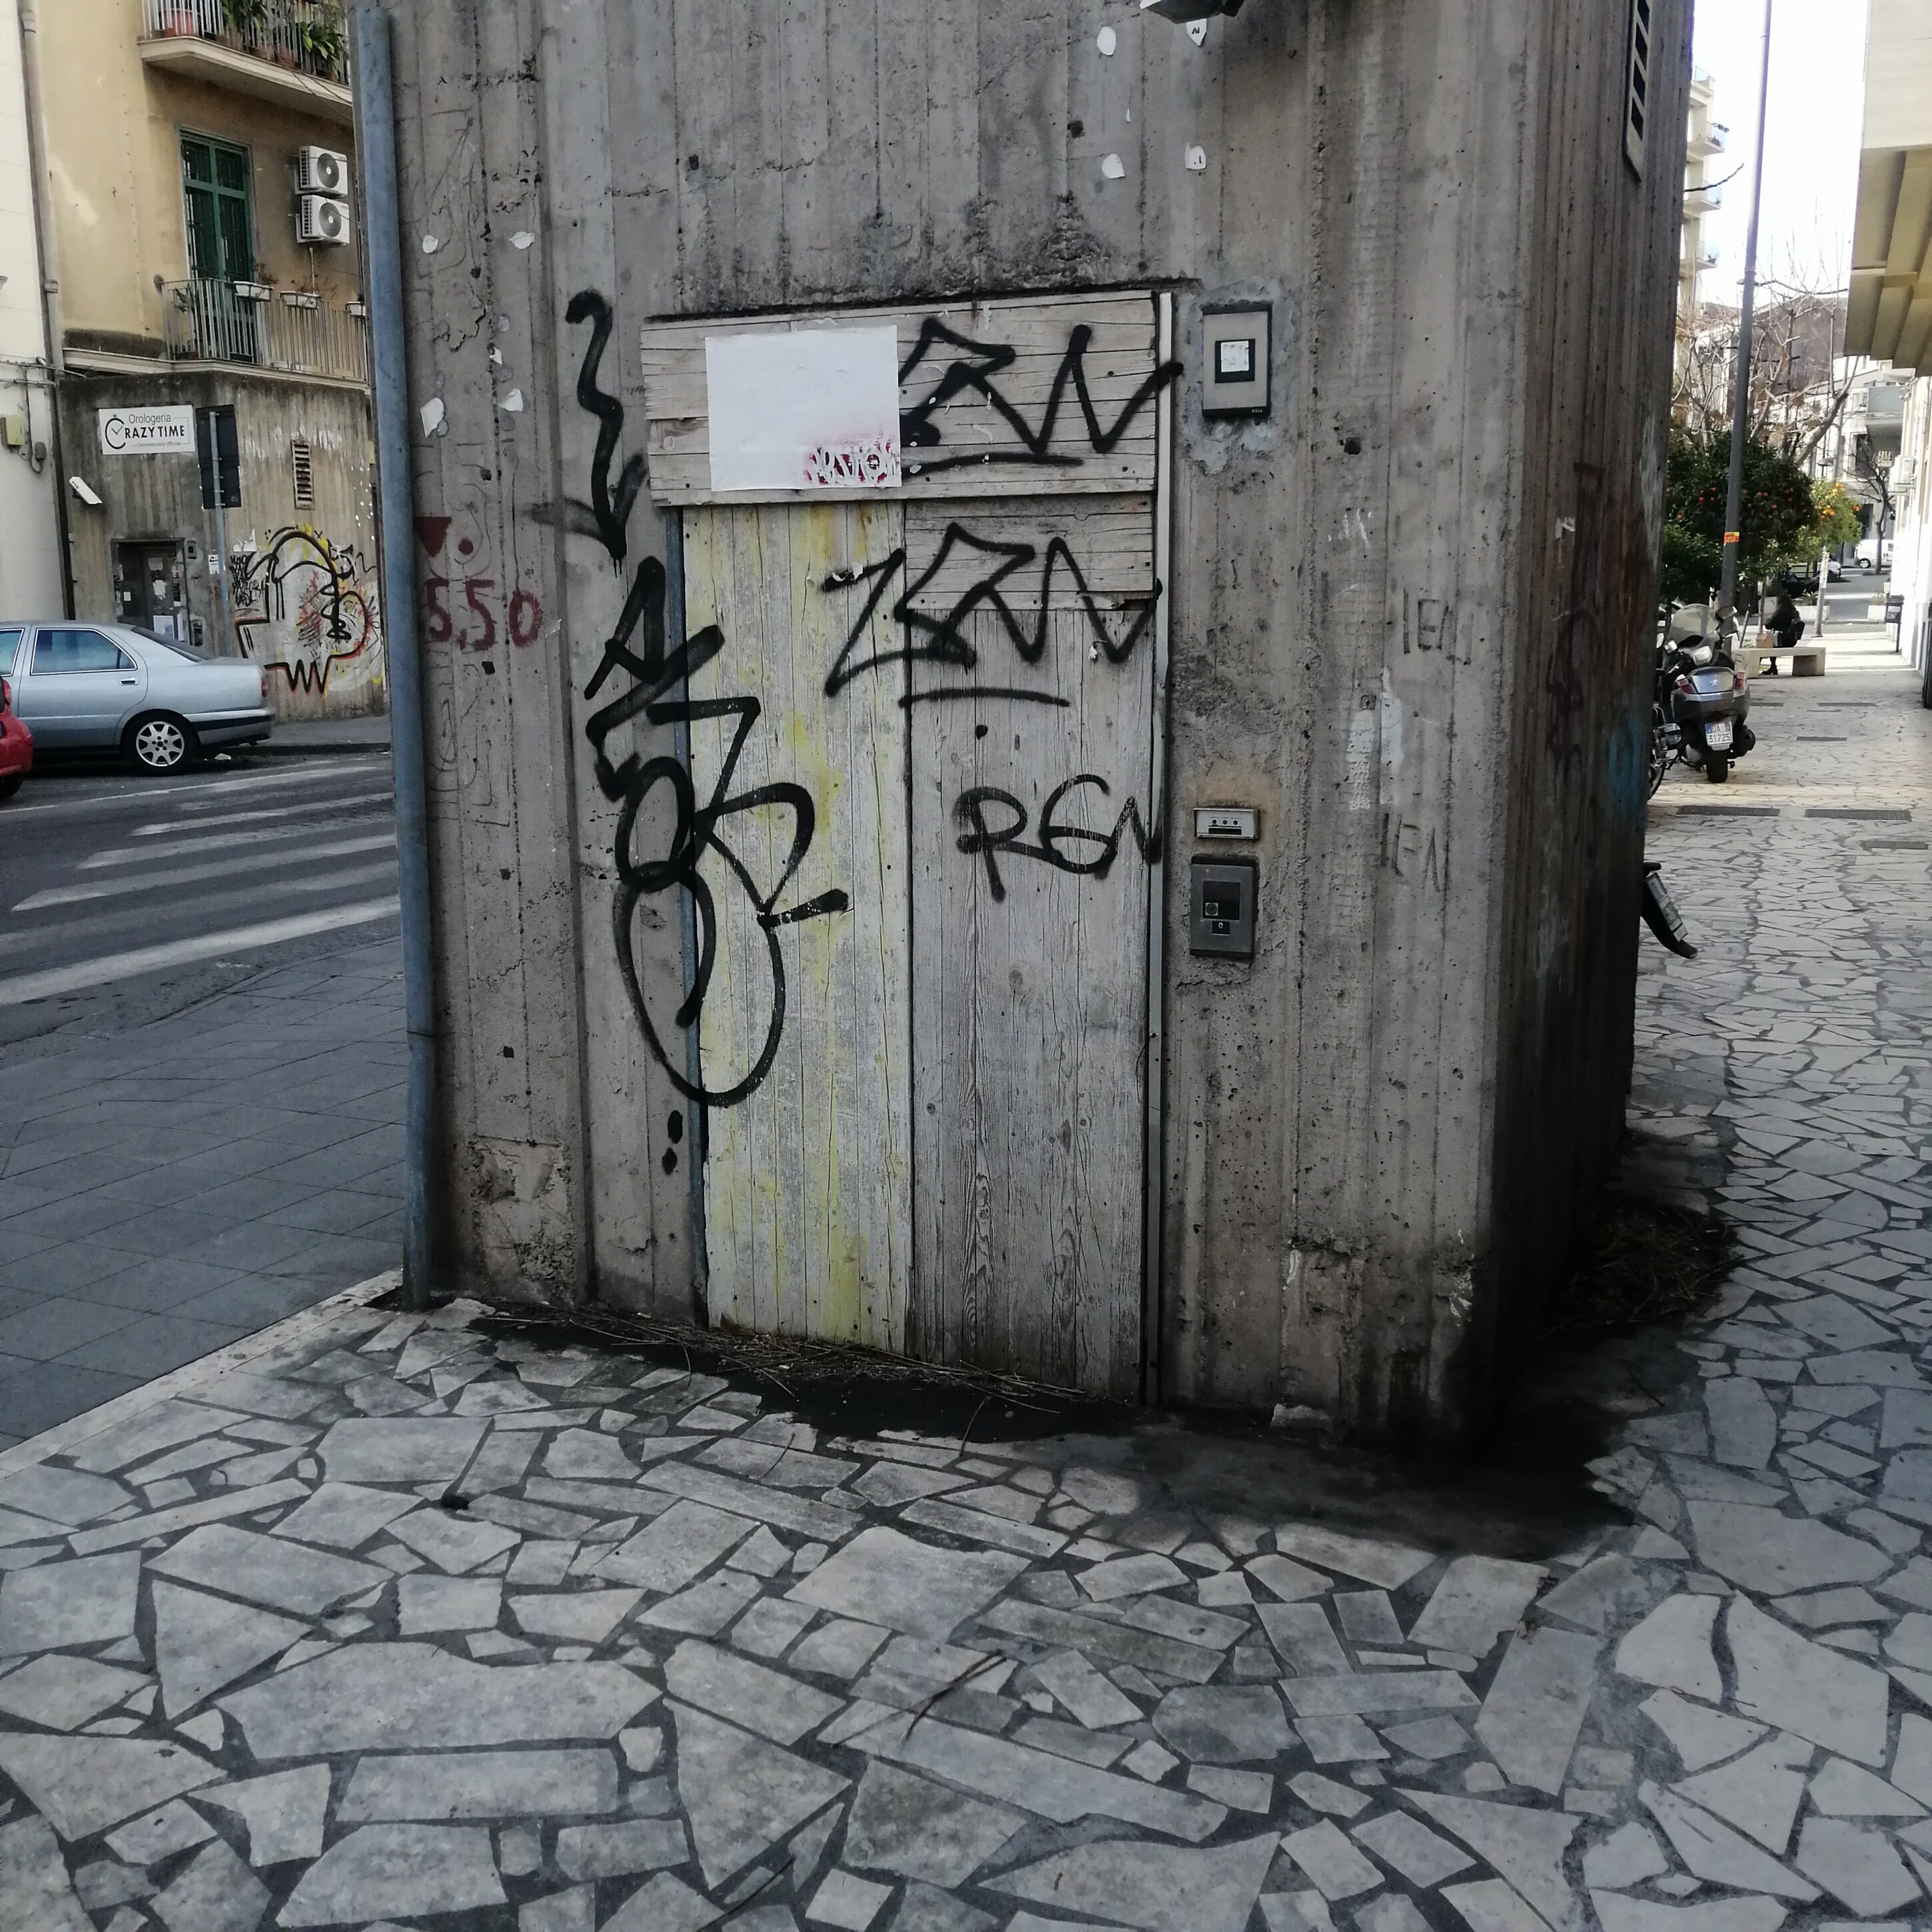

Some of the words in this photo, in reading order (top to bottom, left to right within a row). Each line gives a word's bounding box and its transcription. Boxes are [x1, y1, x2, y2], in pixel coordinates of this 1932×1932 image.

[129, 413, 171, 425] Orologeria
[157, 425, 185, 438] TIME
[1708, 733, 1731, 743] 31725
